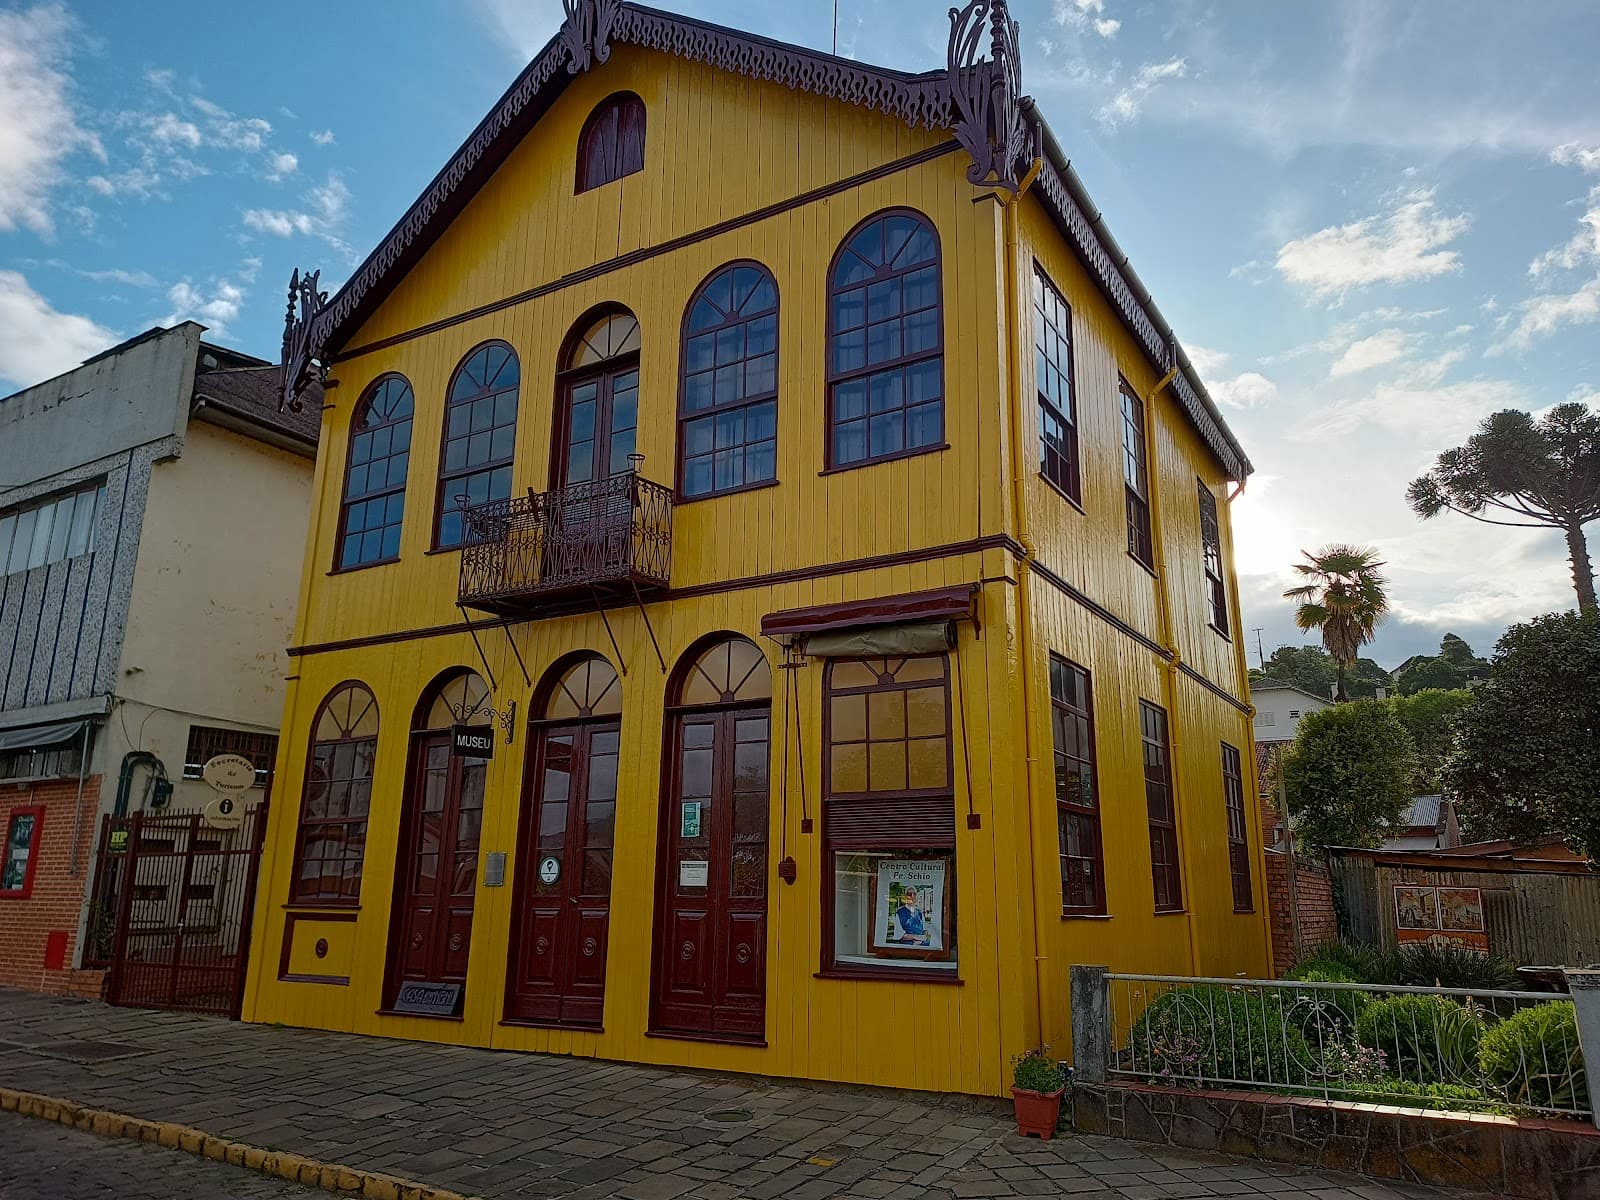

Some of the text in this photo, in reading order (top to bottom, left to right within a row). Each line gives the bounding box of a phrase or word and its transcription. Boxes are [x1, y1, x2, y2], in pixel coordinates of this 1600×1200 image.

[457, 735, 491, 749] MUSEU
[111, 831, 128, 842] HP
[880, 862, 944, 871] Centro Cultural
[908, 871, 931, 880] Schio
